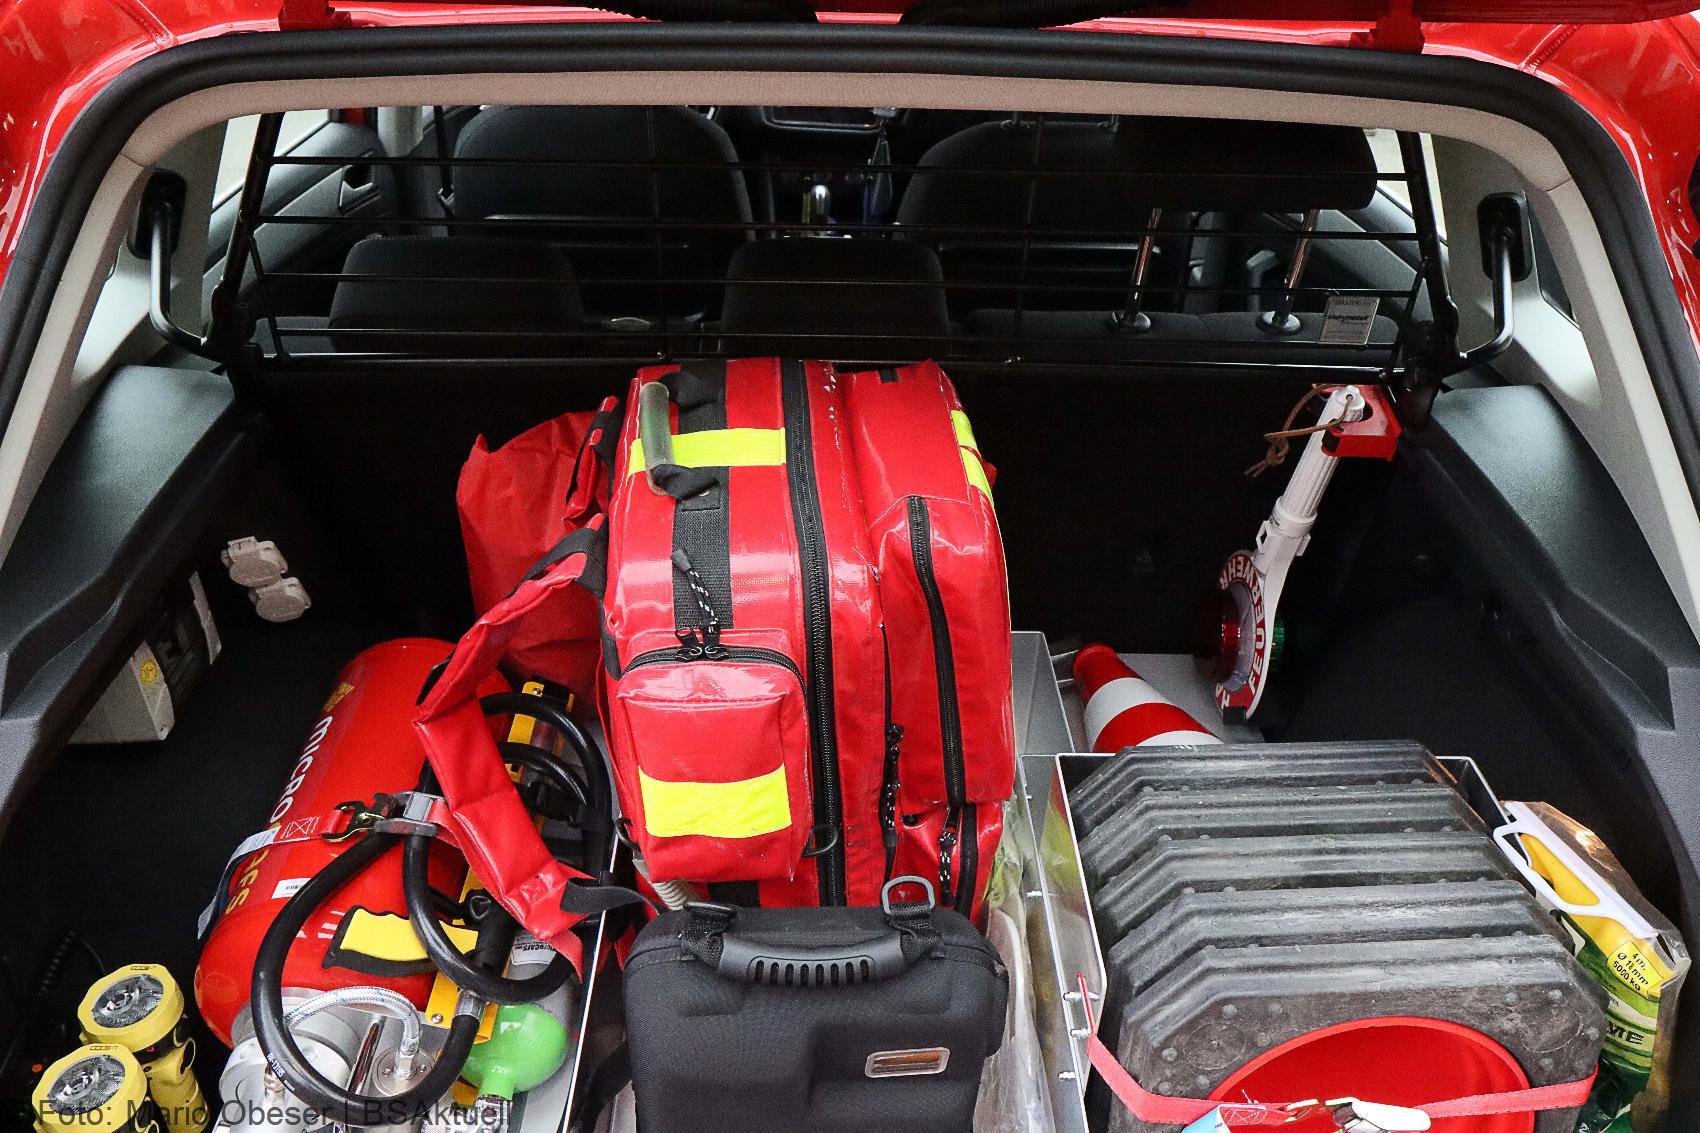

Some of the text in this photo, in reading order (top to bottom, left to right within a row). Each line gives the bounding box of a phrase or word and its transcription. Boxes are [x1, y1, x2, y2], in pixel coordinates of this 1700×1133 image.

[1219, 555, 1265, 695] FEUERWEHR
[269, 715, 333, 823] MICRO
[1612, 960, 1630, 981] 5000
[1629, 977, 1641, 991] kg
[1631, 968, 1649, 985] mm
